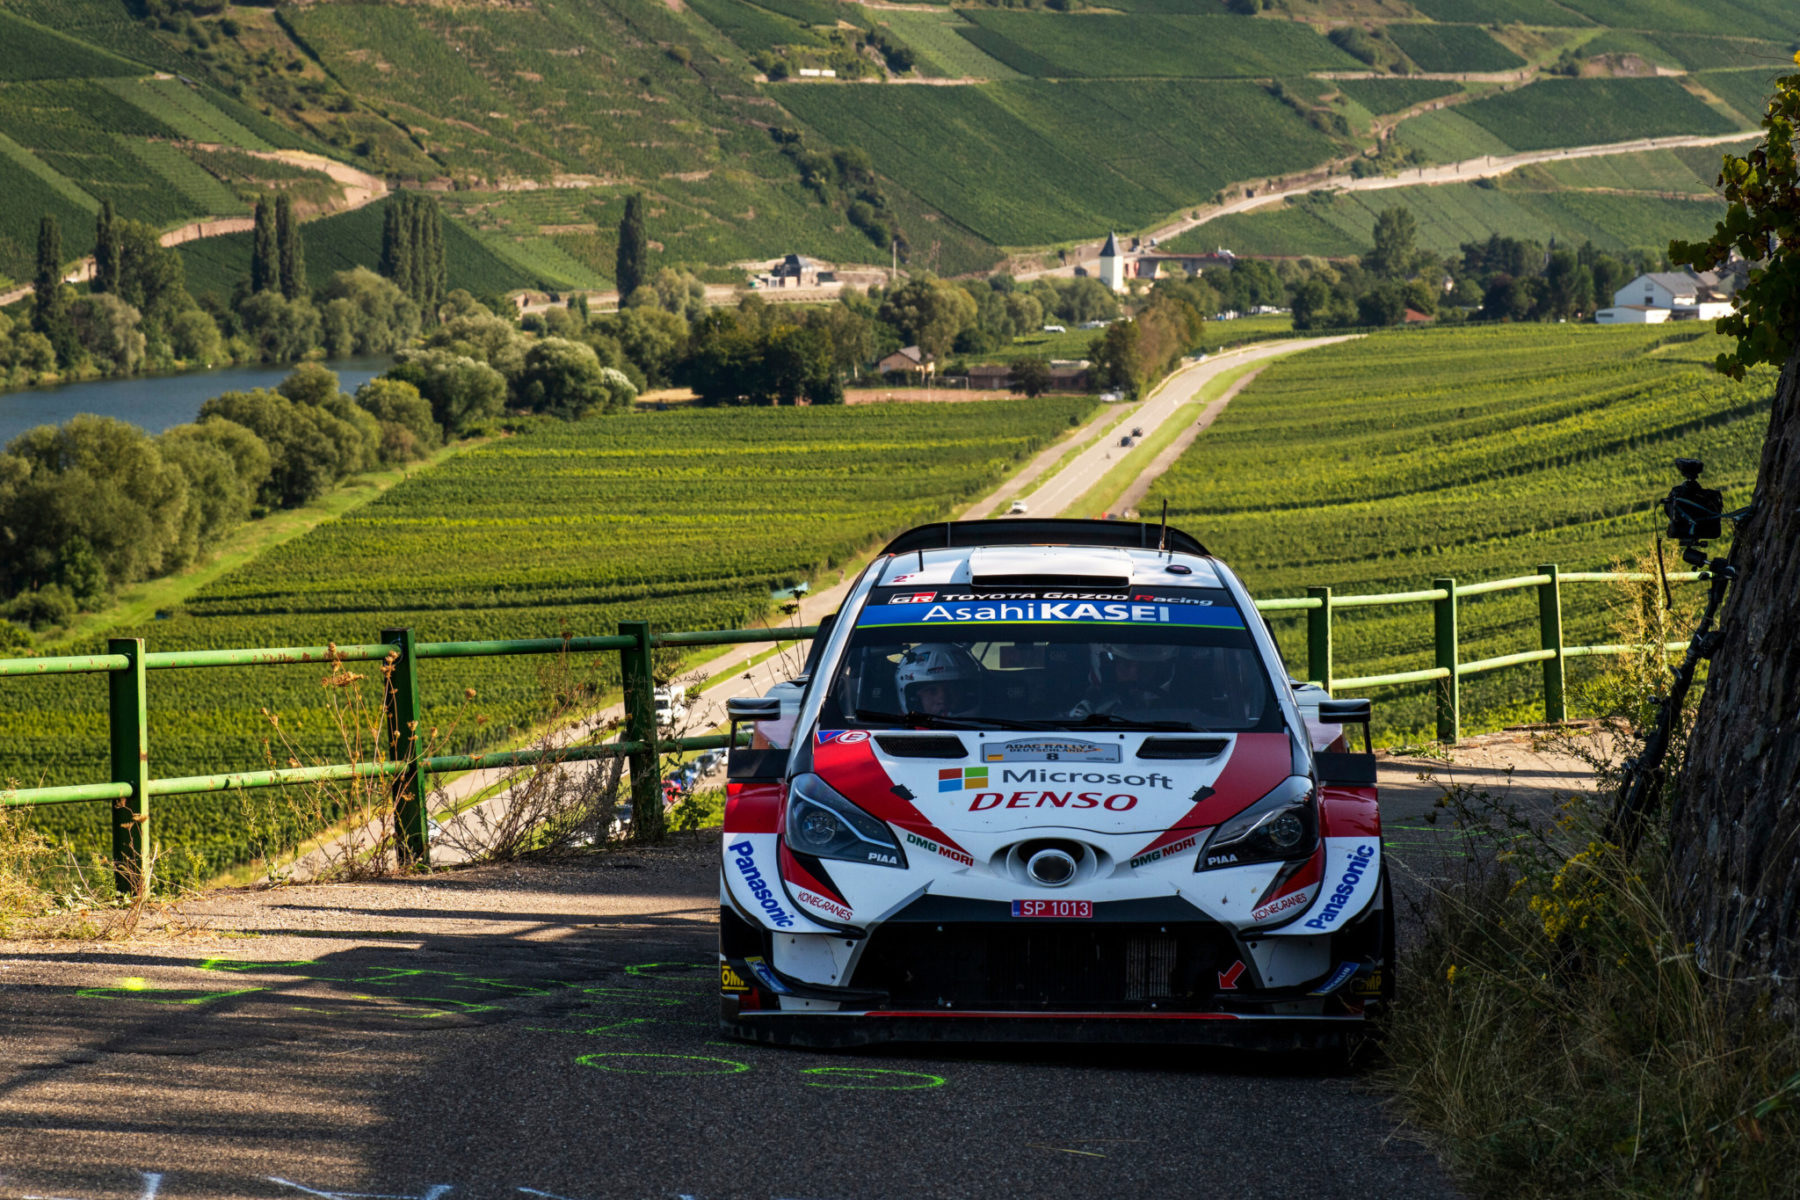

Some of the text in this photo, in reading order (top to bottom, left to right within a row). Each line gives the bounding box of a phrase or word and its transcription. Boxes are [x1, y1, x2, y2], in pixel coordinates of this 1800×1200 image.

[890, 592, 1213, 606] GR TOYOTA GAZOO Racing
[1046, 752, 1059, 761] 8
[1002, 768, 1173, 790] Microsoft
[968, 791, 1138, 812] DENSO
[867, 852, 898, 865] PIAA
[906, 833, 975, 867] DMG MORI
[1130, 837, 1197, 869] DMG MORI
[1207, 853, 1239, 866] PIAA
[728, 840, 795, 928] Panasonic
[1304, 845, 1375, 930] Panasonic
[797, 891, 854, 921] KONECRANES
[1023, 901, 1089, 916] SP 1013
[1251, 893, 1308, 922] KONECRANES
